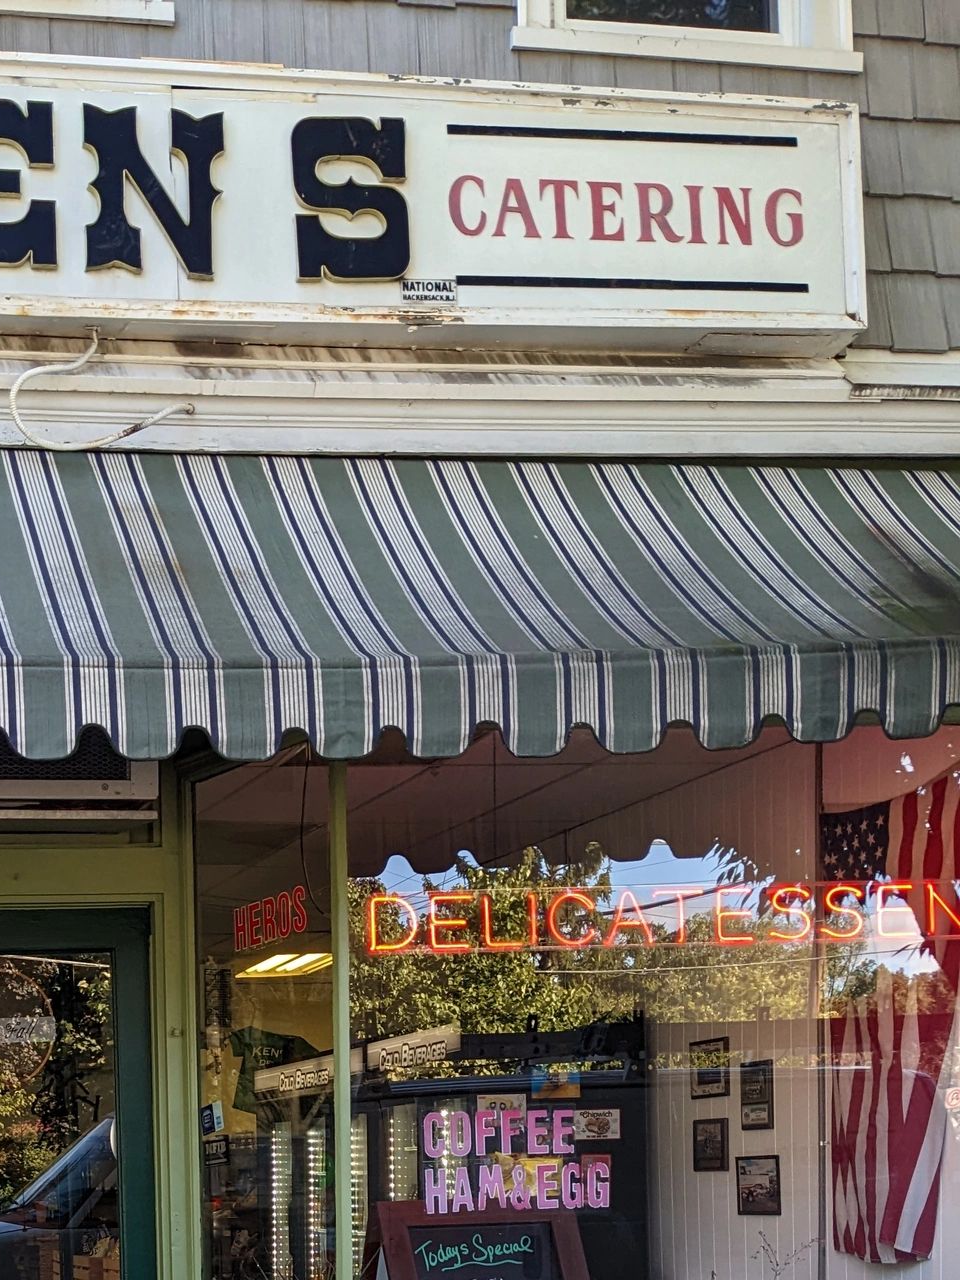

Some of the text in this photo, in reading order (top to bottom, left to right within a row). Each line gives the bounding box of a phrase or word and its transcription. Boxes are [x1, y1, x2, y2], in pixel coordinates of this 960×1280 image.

[448, 174, 805, 248] CATERING
[402, 281, 455, 292] NATIONAL
[233, 885, 308, 952] HEROS
[369, 881, 960, 952] DELICATESSEN
[4, 1020, 39, 1039] Fall
[423, 1109, 575, 1158] COFFEE
[580, 1111, 613, 1119] Chipwich
[424, 1162, 611, 1215] HAM&EGG
[415, 1233, 534, 1272] Todays Special
